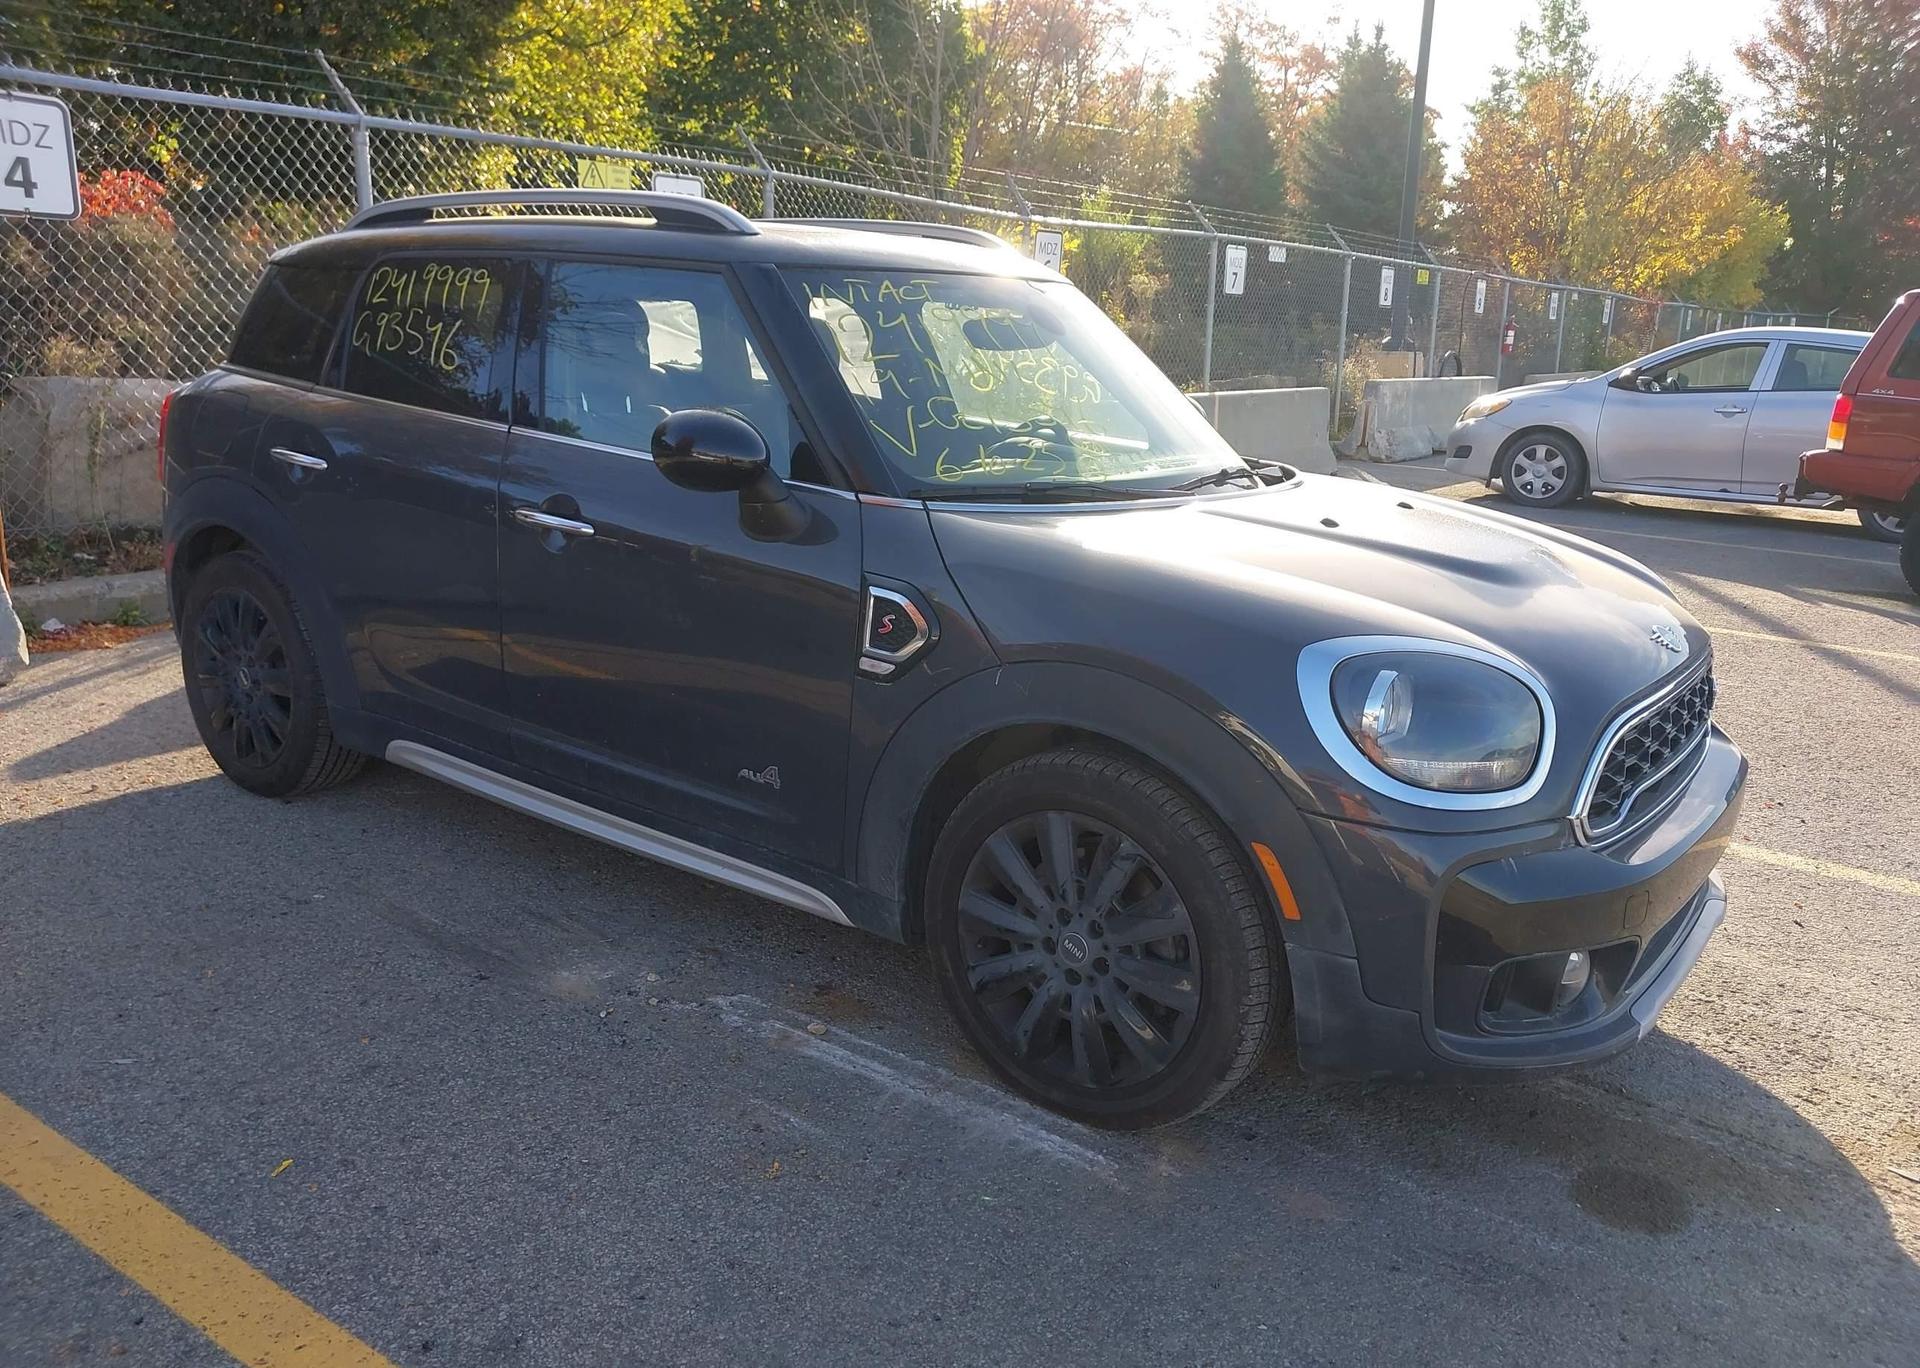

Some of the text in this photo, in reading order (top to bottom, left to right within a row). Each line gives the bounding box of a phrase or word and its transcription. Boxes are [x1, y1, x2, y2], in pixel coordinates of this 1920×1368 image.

[4, 155, 39, 199] 4
[1038, 240, 1058, 256] MDZ
[1231, 271, 1239, 290] 7
[365, 262, 491, 322] 12419999
[802, 278, 940, 310] INTACT
[877, 614, 897, 635] S
[1063, 938, 1084, 960] MINI
